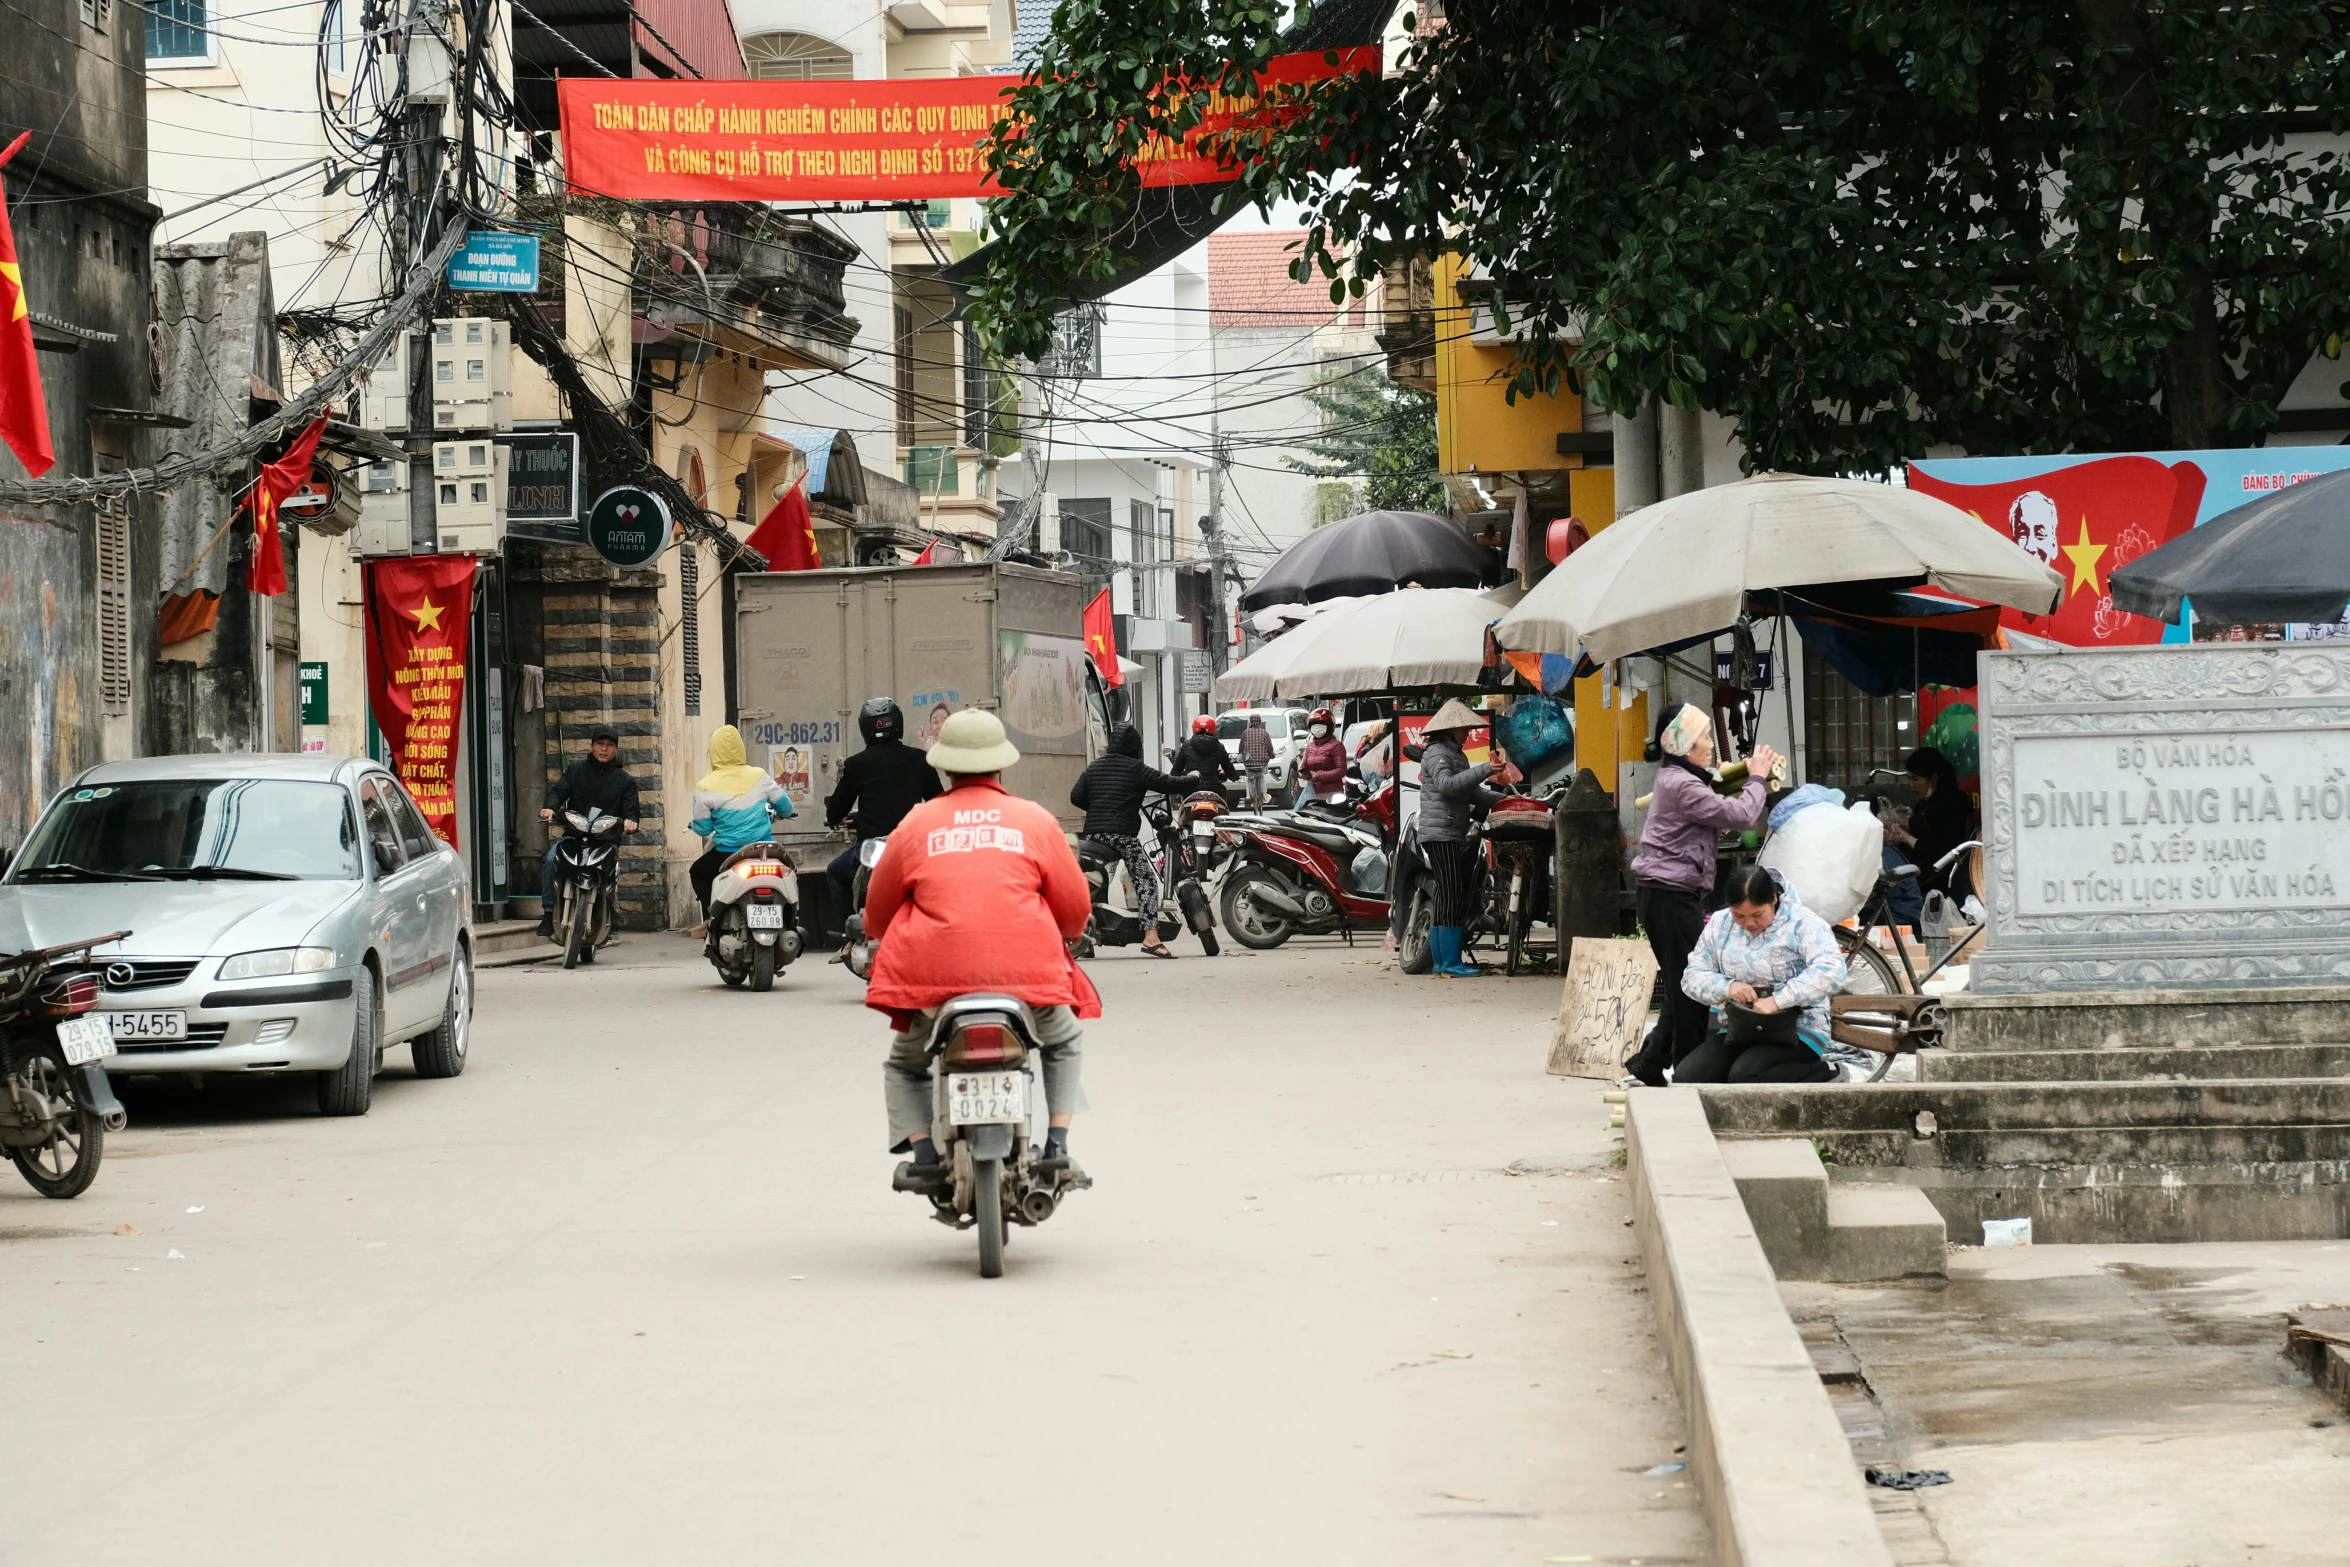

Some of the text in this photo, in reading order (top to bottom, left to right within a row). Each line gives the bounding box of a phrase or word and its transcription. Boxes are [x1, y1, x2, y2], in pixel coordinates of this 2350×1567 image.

[593, 99, 633, 130] TOÀN
[638, 101, 670, 132] DÂN
[674, 99, 714, 133] CHẤP
[719, 104, 761, 134] HÀNH
[765, 103, 826, 134] NGHIÊM
[830, 99, 877, 133] CHỈNH
[881, 102, 912, 133] CÁC
[917, 106, 946, 135] QUY
[950, 104, 988, 137] ĐỊNH
[644, 143, 666, 173] VÀ
[669, 144, 711, 175] CÔNG
[715, 150, 736, 181] CỤ
[739, 141, 760, 176] HỖ
[764, 148, 794, 182] TRỢ
[797, 150, 835, 176] THEO
[840, 149, 876, 181] NGHỊ
[880, 149, 918, 181] ĐỊNH
[922, 139, 943, 174] SỐ
[947, 148, 974, 173] 137
[468, 252, 516, 267] ĐOẠN ĐƯỜNG
[453, 269, 530, 286] THANH NIÊN TỰ QUẢN
[526, 441, 568, 472] THUỐC
[2243, 471, 2269, 490] ĐẢNG
[508, 486, 565, 511] LINH
[608, 543, 646, 551] PHARMA
[768, 647, 805, 656] THACO
[913, 639, 970, 649] FRONTIER
[408, 646, 453, 663] XÂY DỰNG
[396, 662, 464, 684] NÔNG THÔN MỚI
[412, 682, 430, 702] KIỂU
[430, 725, 451, 739] CAO
[755, 721, 840, 744] 29C-862.31
[420, 740, 448, 759] SỐNG
[2116, 732, 2254, 775] BỘ VĂN HÓA
[420, 760, 447, 779] CHẤT,
[423, 779, 447, 796] THẦN
[2021, 778, 2109, 828] ĐÌNH
[2118, 776, 2220, 825] LÀNG
[2231, 773, 2284, 822] HÀ
[954, 809, 1001, 824] MDC
[930, 828, 1021, 854] team
[2112, 826, 2266, 868] ĐÃ XẾP HẠNG
[2042, 863, 2336, 907] DI TÍCH LỊCH SỬ VĂN HÓA
[752, 906, 777, 916] 29-Y5
[750, 916, 781, 927] 260.88
[68, 1037, 113, 1062] 079.15
[961, 1098, 1011, 1119] 0024
